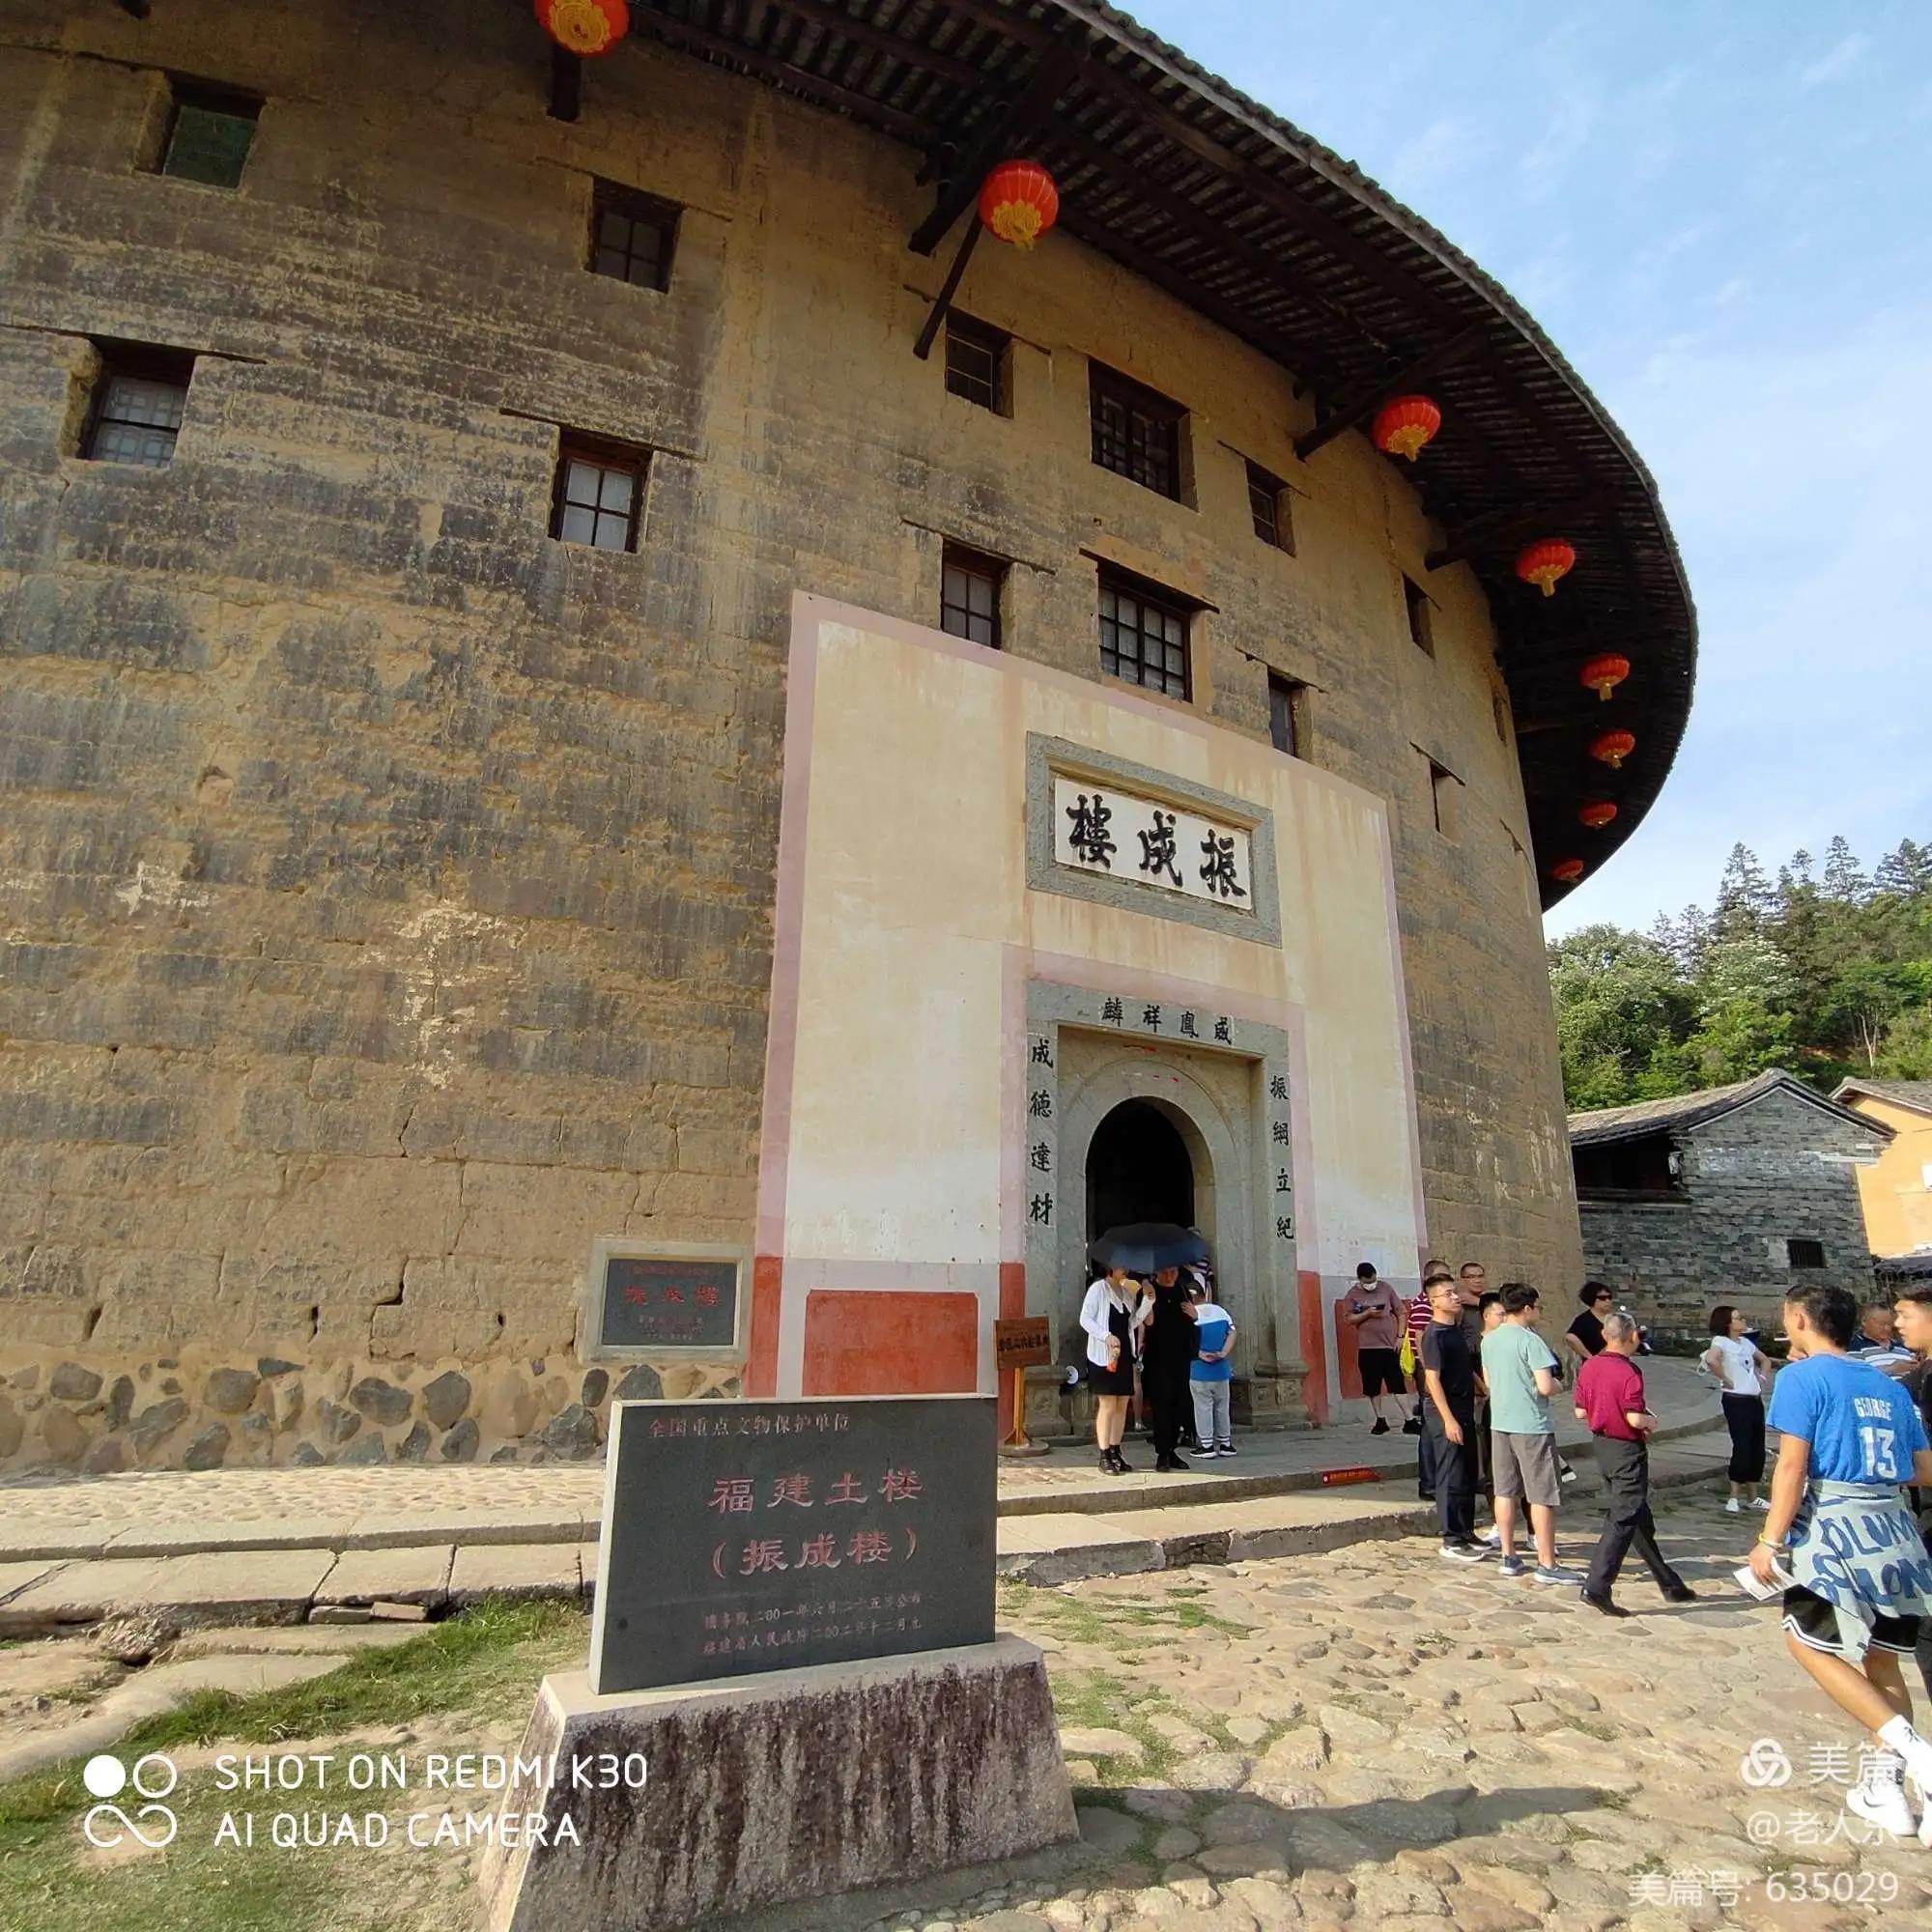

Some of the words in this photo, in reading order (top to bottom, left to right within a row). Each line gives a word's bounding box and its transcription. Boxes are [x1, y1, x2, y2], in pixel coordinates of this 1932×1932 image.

[648, 1412, 852, 1438] 全国重点文物保护单位
[1860, 1426, 1898, 1479] 13
[708, 1468, 923, 1513] 福建土楼
